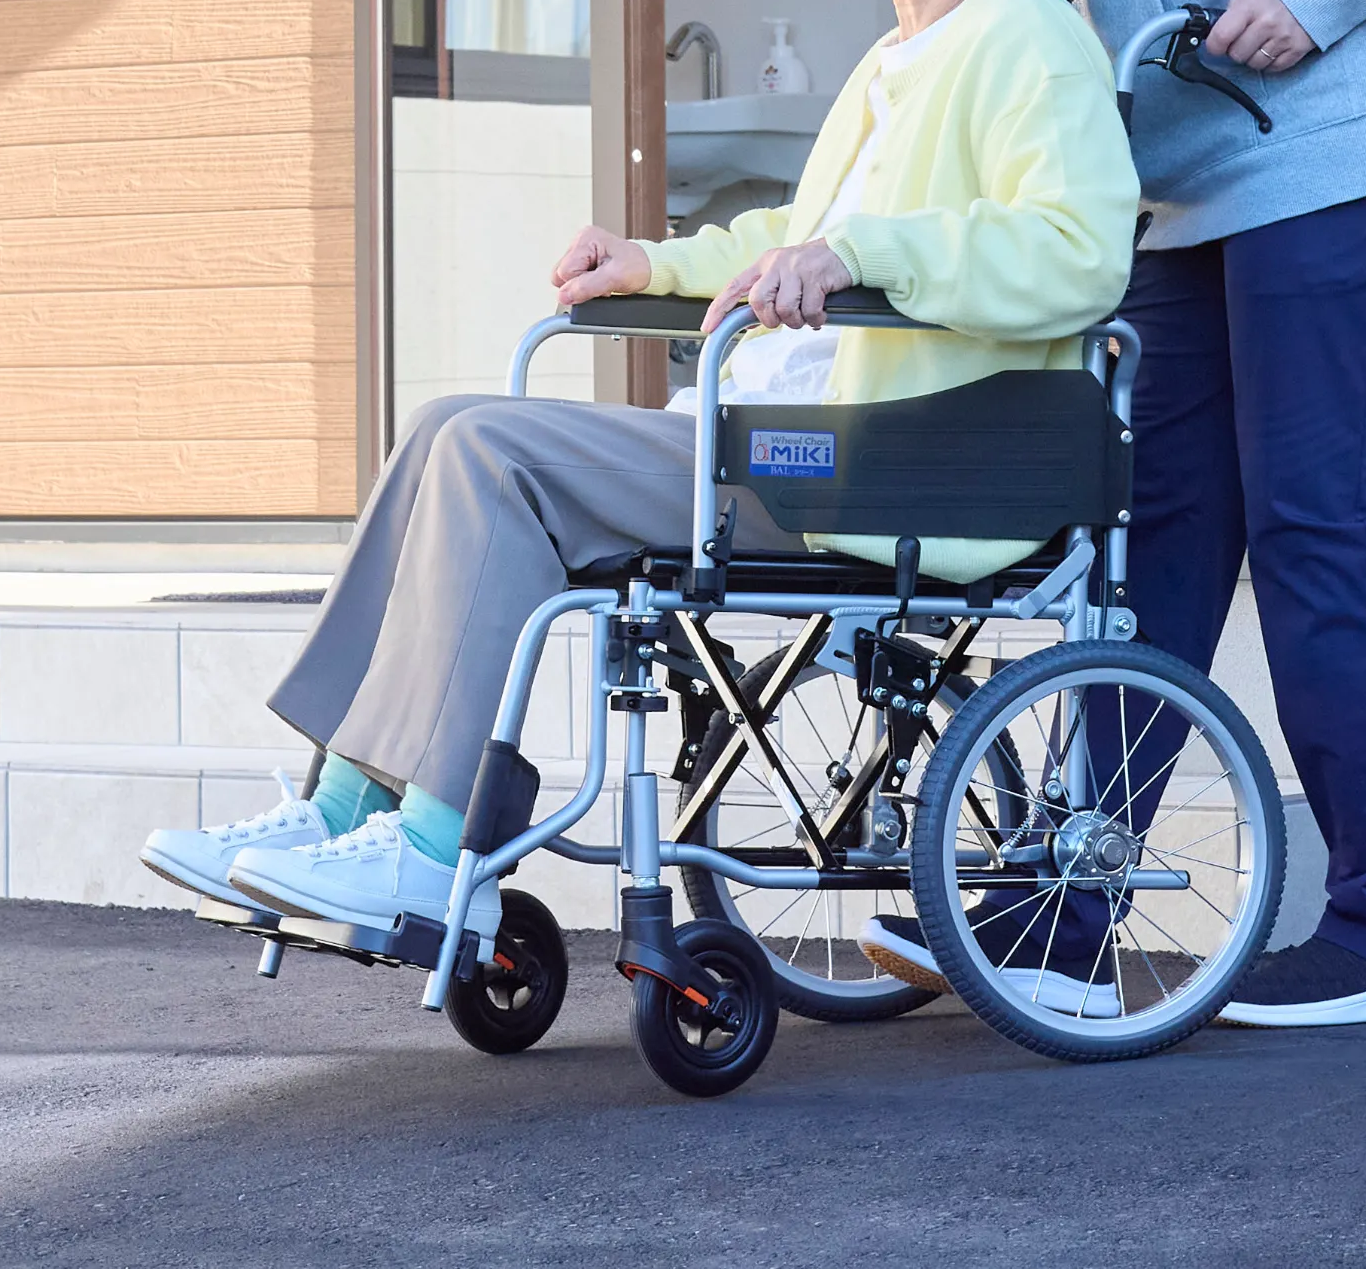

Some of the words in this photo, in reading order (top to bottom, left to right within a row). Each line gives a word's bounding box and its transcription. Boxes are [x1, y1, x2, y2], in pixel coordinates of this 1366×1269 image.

[771, 436, 802, 445] Wheel
[804, 436, 831, 446] Chair
[770, 466, 790, 475] BAL
